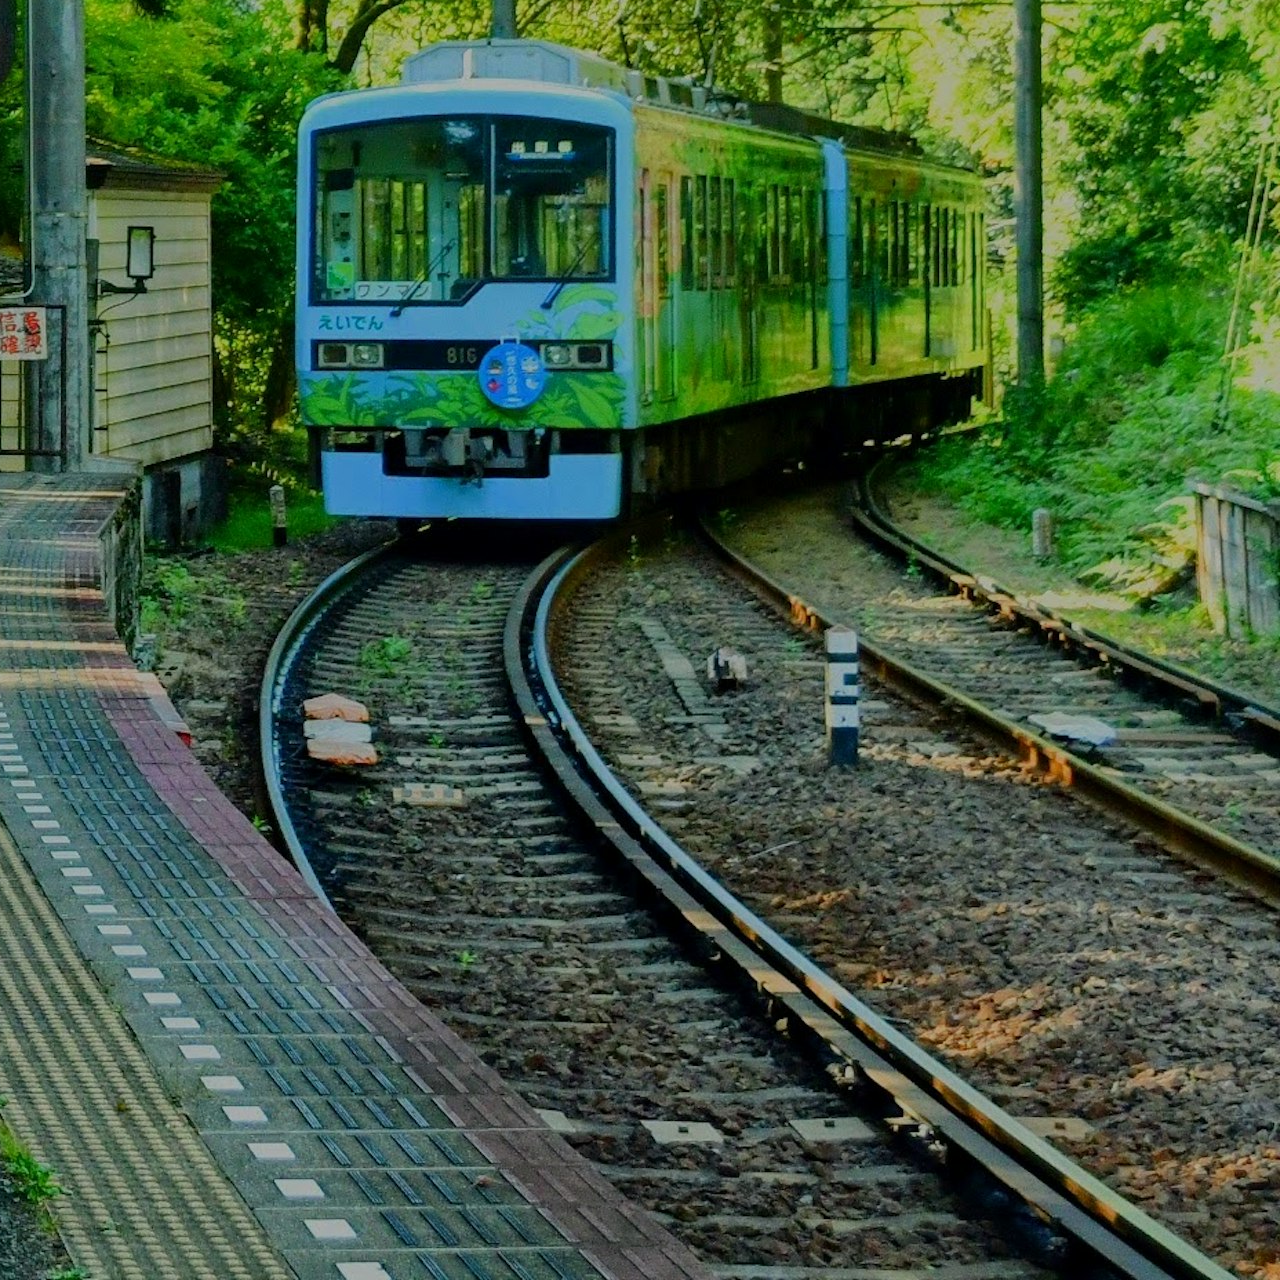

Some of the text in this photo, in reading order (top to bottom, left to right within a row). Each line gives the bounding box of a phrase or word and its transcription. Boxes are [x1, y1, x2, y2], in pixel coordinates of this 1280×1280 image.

[357, 283, 430, 298] ワンマン
[318, 315, 384, 331] えいでん
[447, 346, 478, 365] 816
